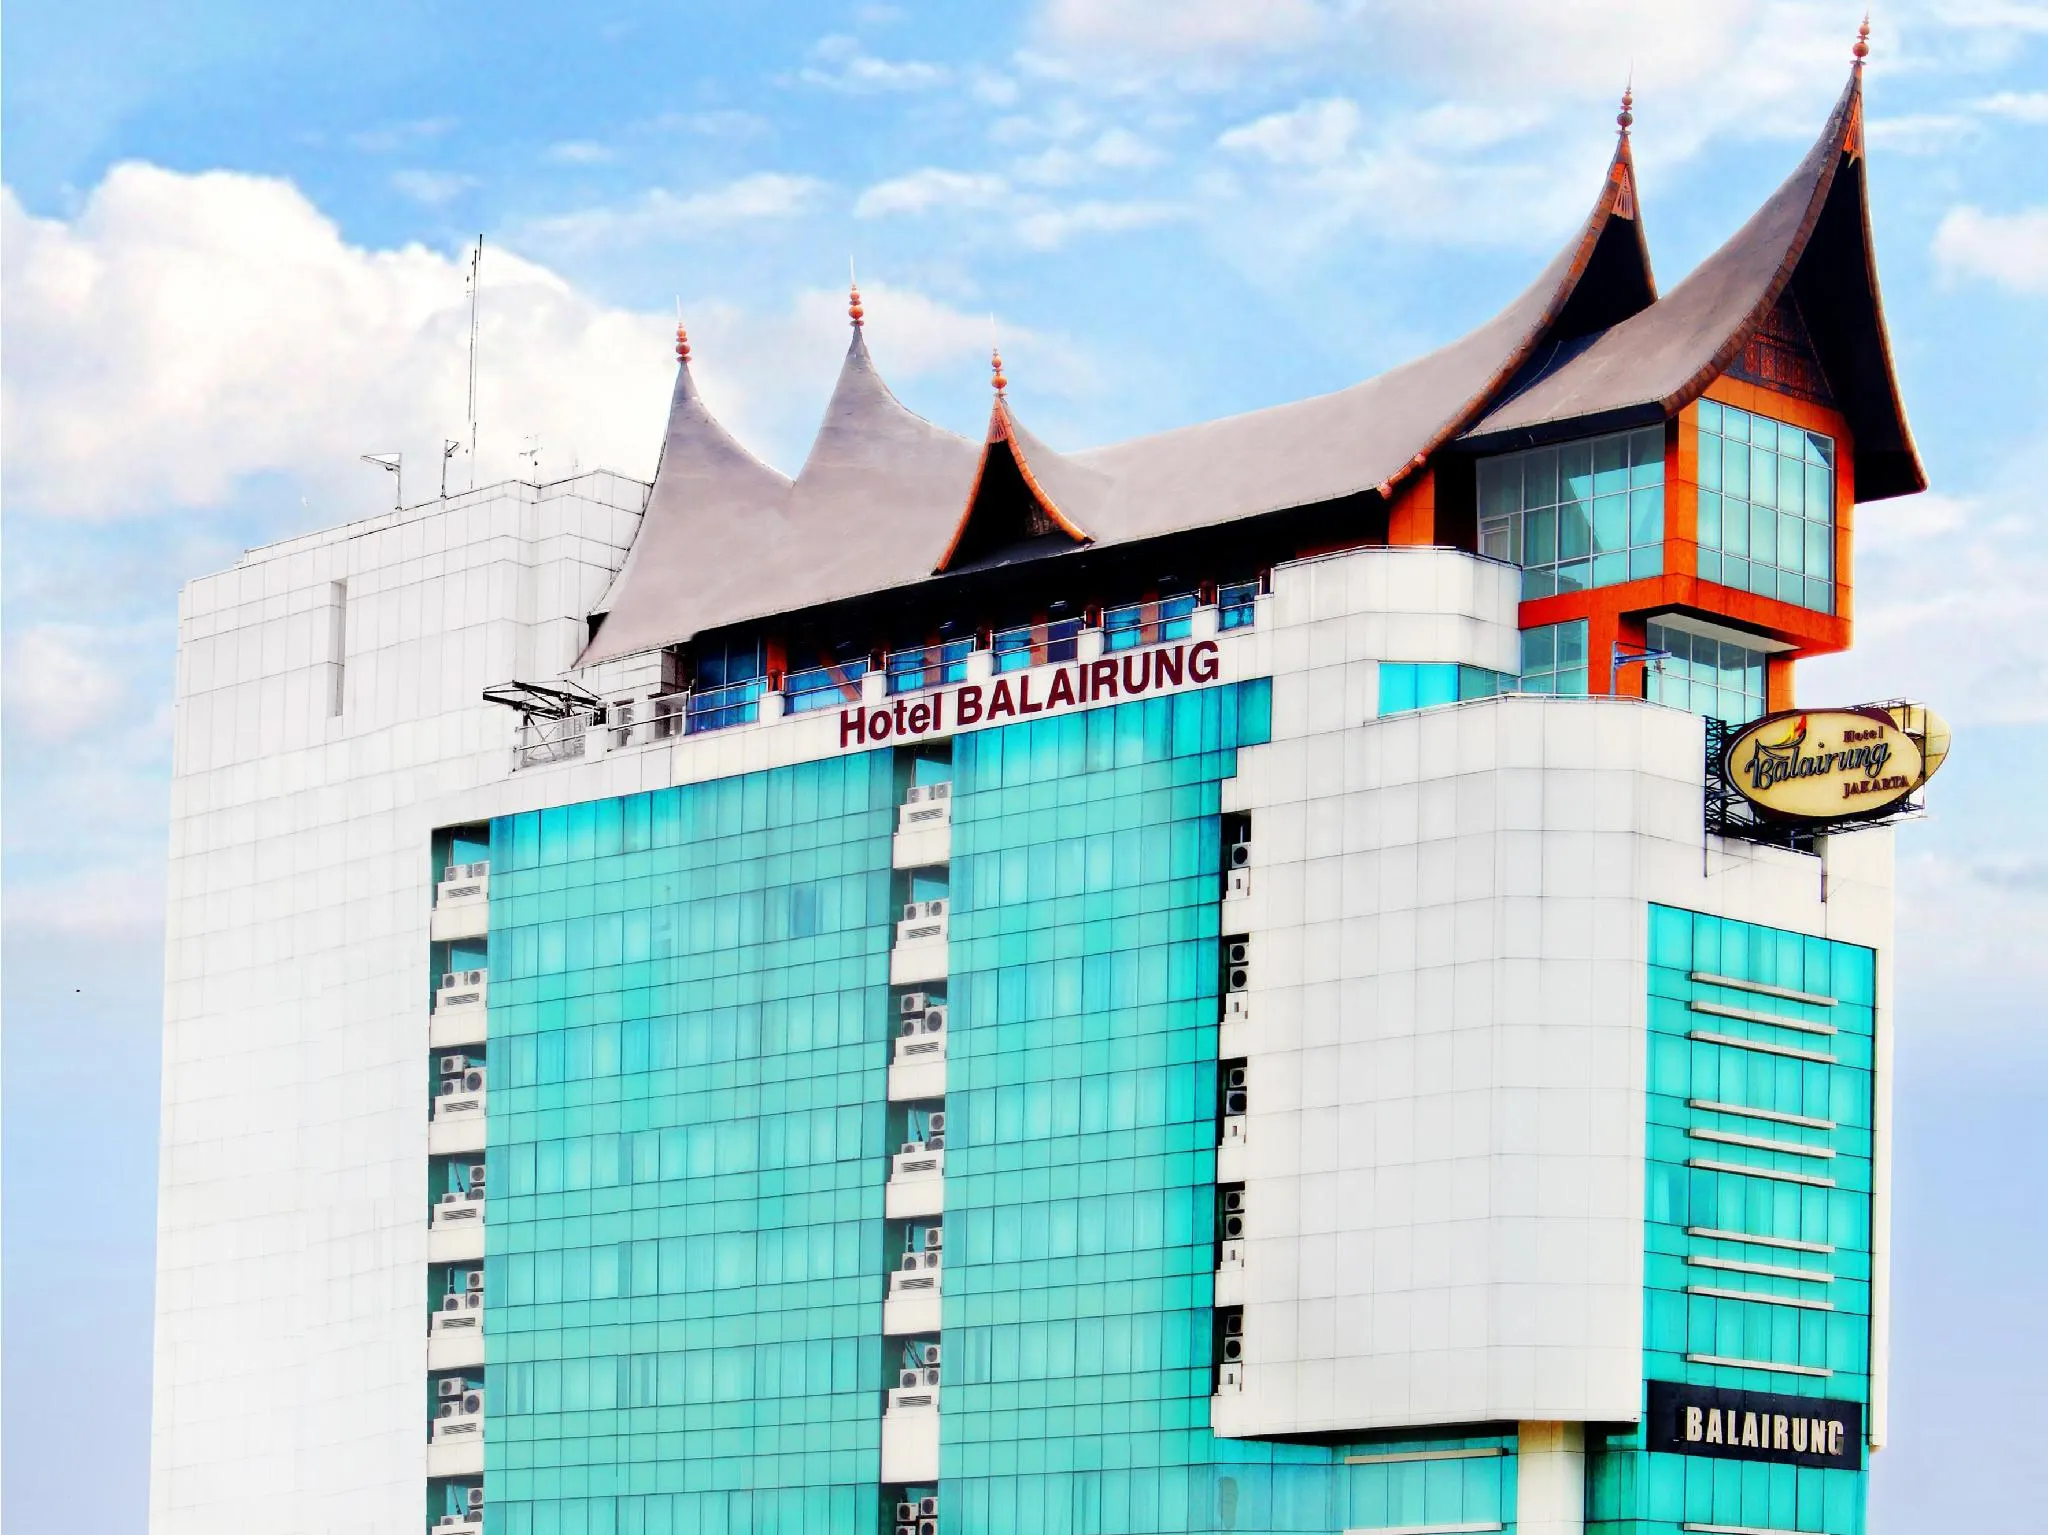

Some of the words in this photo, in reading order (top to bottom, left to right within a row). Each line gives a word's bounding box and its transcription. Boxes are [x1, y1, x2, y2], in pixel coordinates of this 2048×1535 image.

[840, 692, 942, 748] Hotel
[956, 639, 1220, 726] BALAIRUNG
[1843, 726, 1884, 743] Hotel
[1744, 740, 1892, 789] Balairung
[1842, 775, 1910, 799] JAKARTA
[1686, 1405, 1845, 1456] BALAIRUNG
